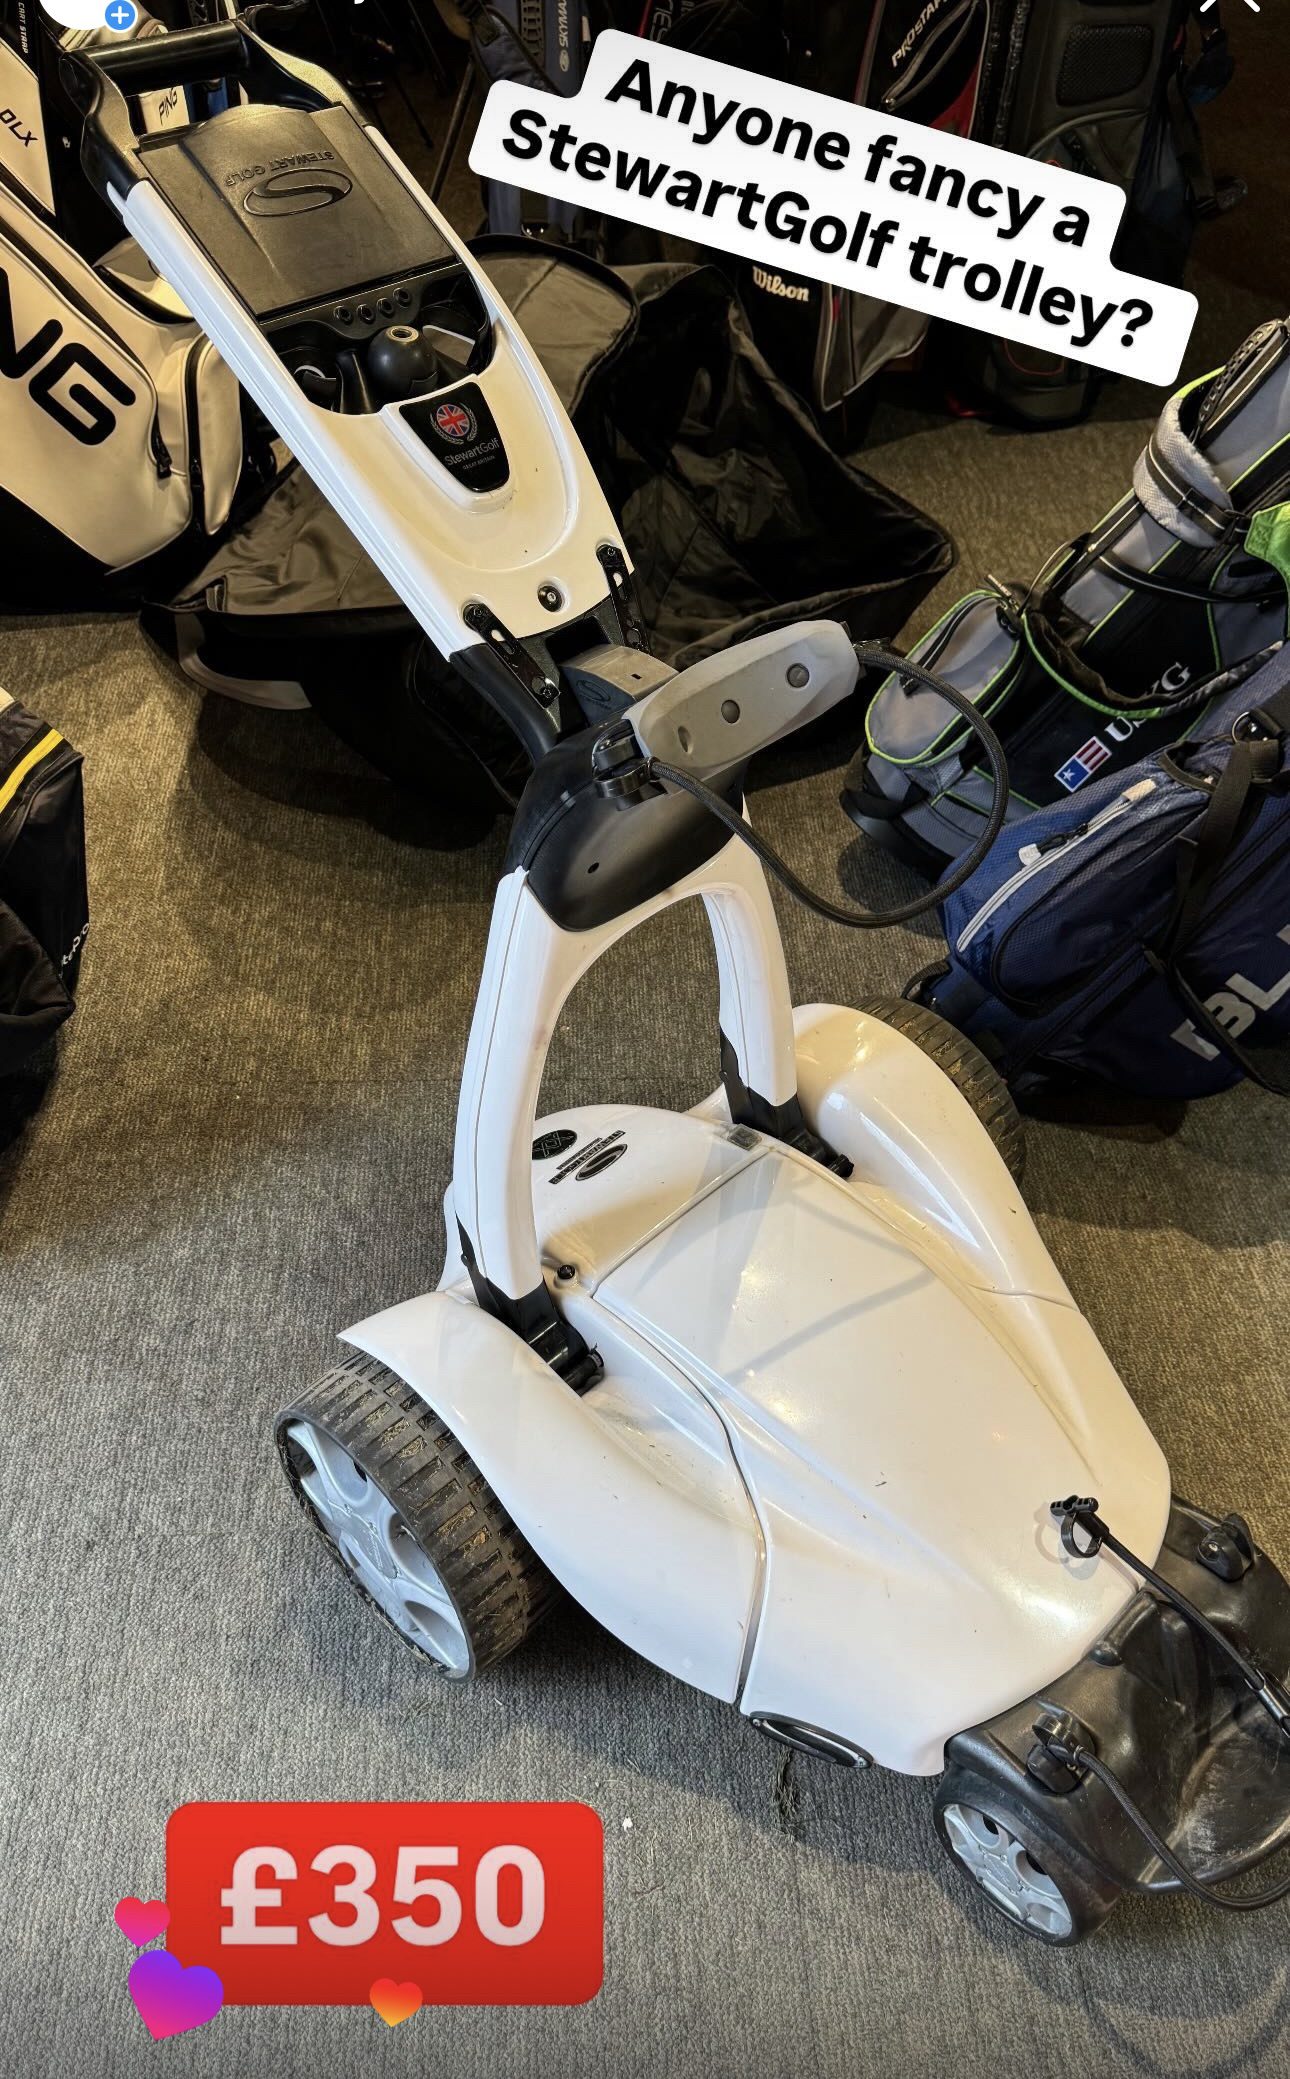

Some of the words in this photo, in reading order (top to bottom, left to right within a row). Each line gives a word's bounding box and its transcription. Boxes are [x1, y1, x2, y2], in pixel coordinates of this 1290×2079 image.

[18, 2, 26, 24] CART
[558, 0, 570, 47] SKYMA
[20, 25, 29, 53] STRAP
[268, 151, 335, 171] STEWART
[225, 165, 266, 187] GOLF
[752, 265, 809, 302] Wilson
[444, 437, 500, 466] StewartGolf
